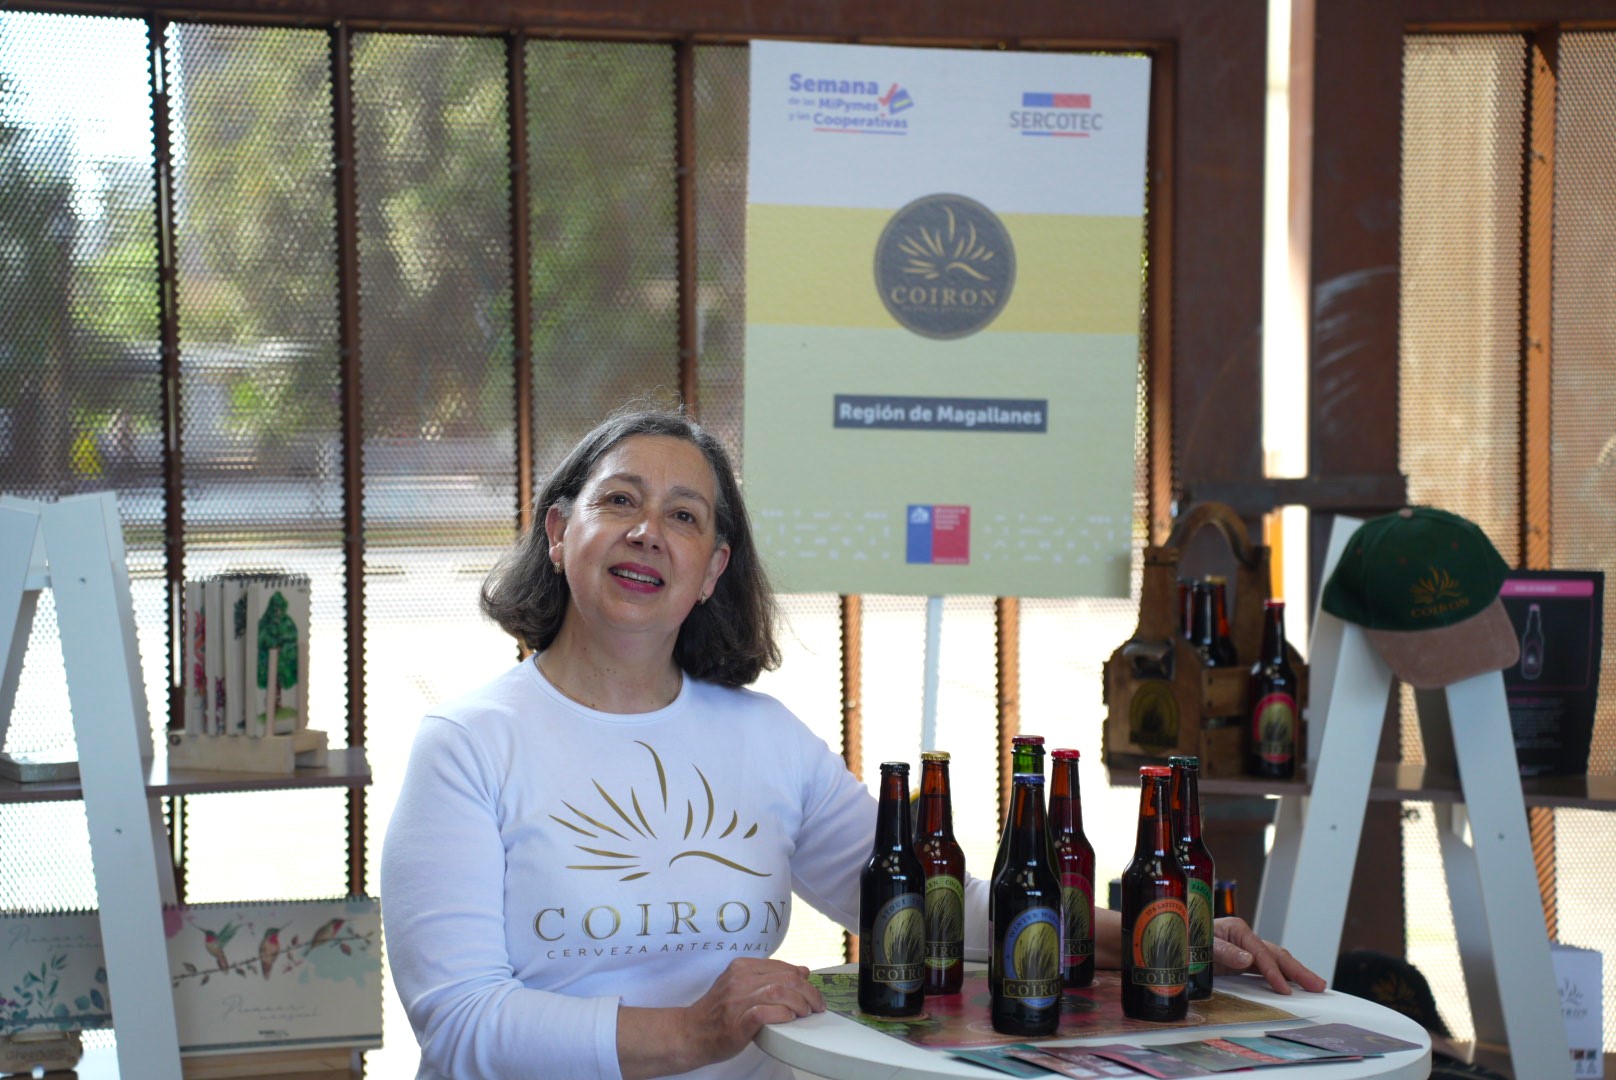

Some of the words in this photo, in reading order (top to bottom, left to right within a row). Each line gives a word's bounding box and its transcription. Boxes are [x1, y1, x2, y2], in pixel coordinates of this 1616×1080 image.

[789, 72, 879, 95] Semana
[819, 97, 879, 113] MiPymes
[813, 112, 909, 129] Cooperativas
[1009, 110, 1103, 131] SERCOTEC
[890, 286, 998, 306] COIRON
[839, 402, 905, 424] Región
[909, 405, 933, 422] de
[937, 406, 1043, 427] Magallanes
[532, 900, 787, 942] COIRON
[546, 945, 648, 960] CERVEZA
[660, 941, 770, 954] ARTESANAL
[876, 966, 924, 980] COIRO
[1135, 972, 1186, 984] COIRO
[1006, 982, 1058, 997] COIRO
